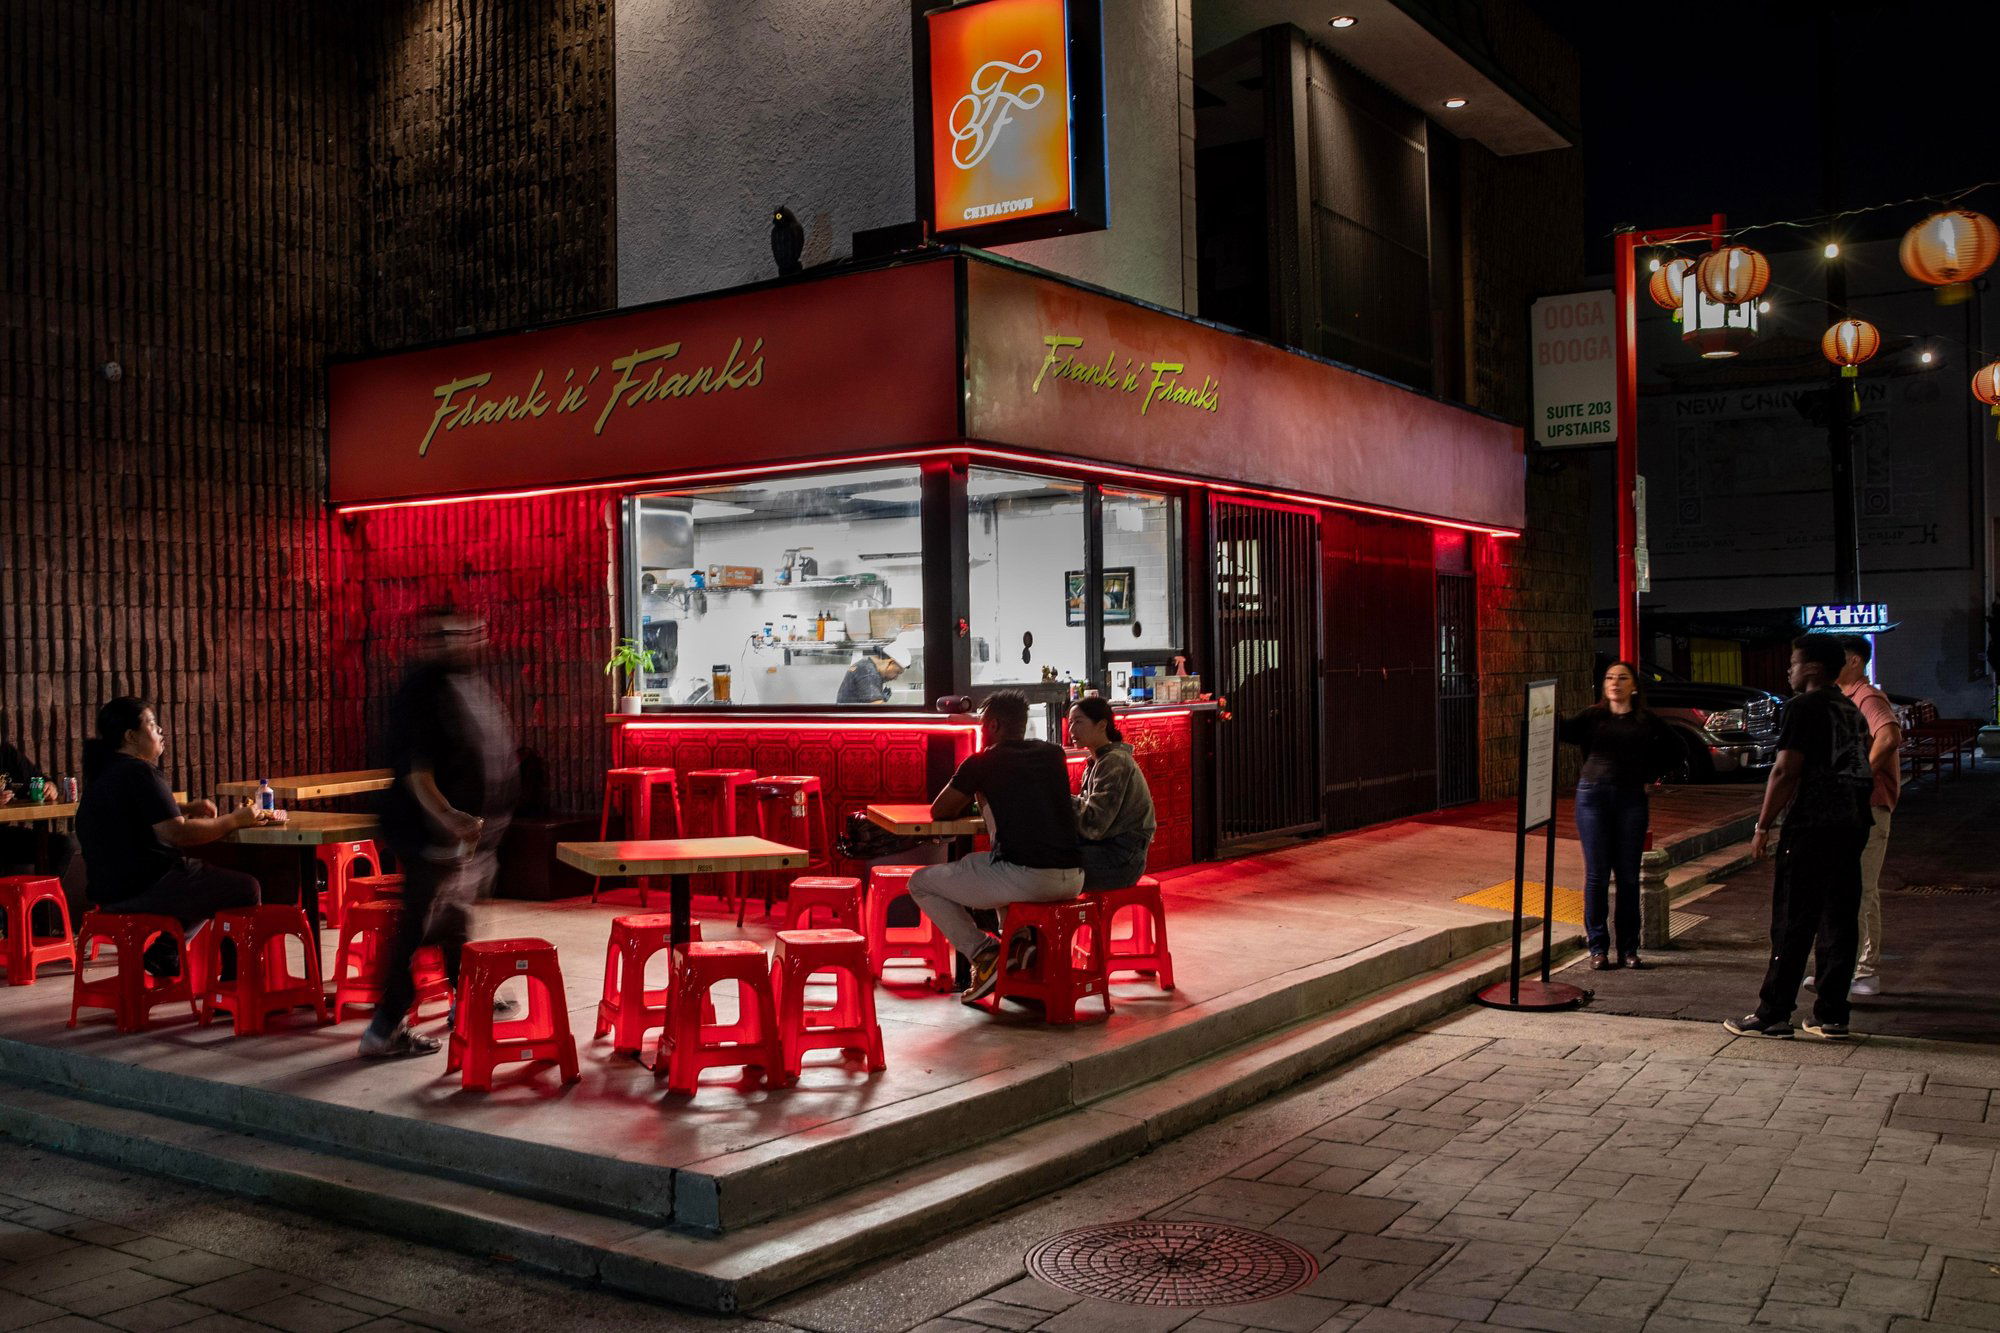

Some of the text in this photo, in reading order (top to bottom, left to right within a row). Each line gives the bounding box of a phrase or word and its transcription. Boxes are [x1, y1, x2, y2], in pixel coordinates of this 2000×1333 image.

[964, 197, 1034, 220] CHINATOWN
[1544, 302, 1605, 330] OOGA
[1538, 336, 1612, 366] BOOGA
[1032, 332, 1119, 394] Frank
[1141, 360, 1218, 416] Frank's
[419, 369, 552, 456] Frank
[594, 337, 764, 436] Frank's
[1676, 397, 1727, 416] NEW
[1547, 401, 1612, 419] SUITE 203
[1548, 420, 1610, 438] UPSTAIRS
[1808, 604, 1873, 625] ATM
